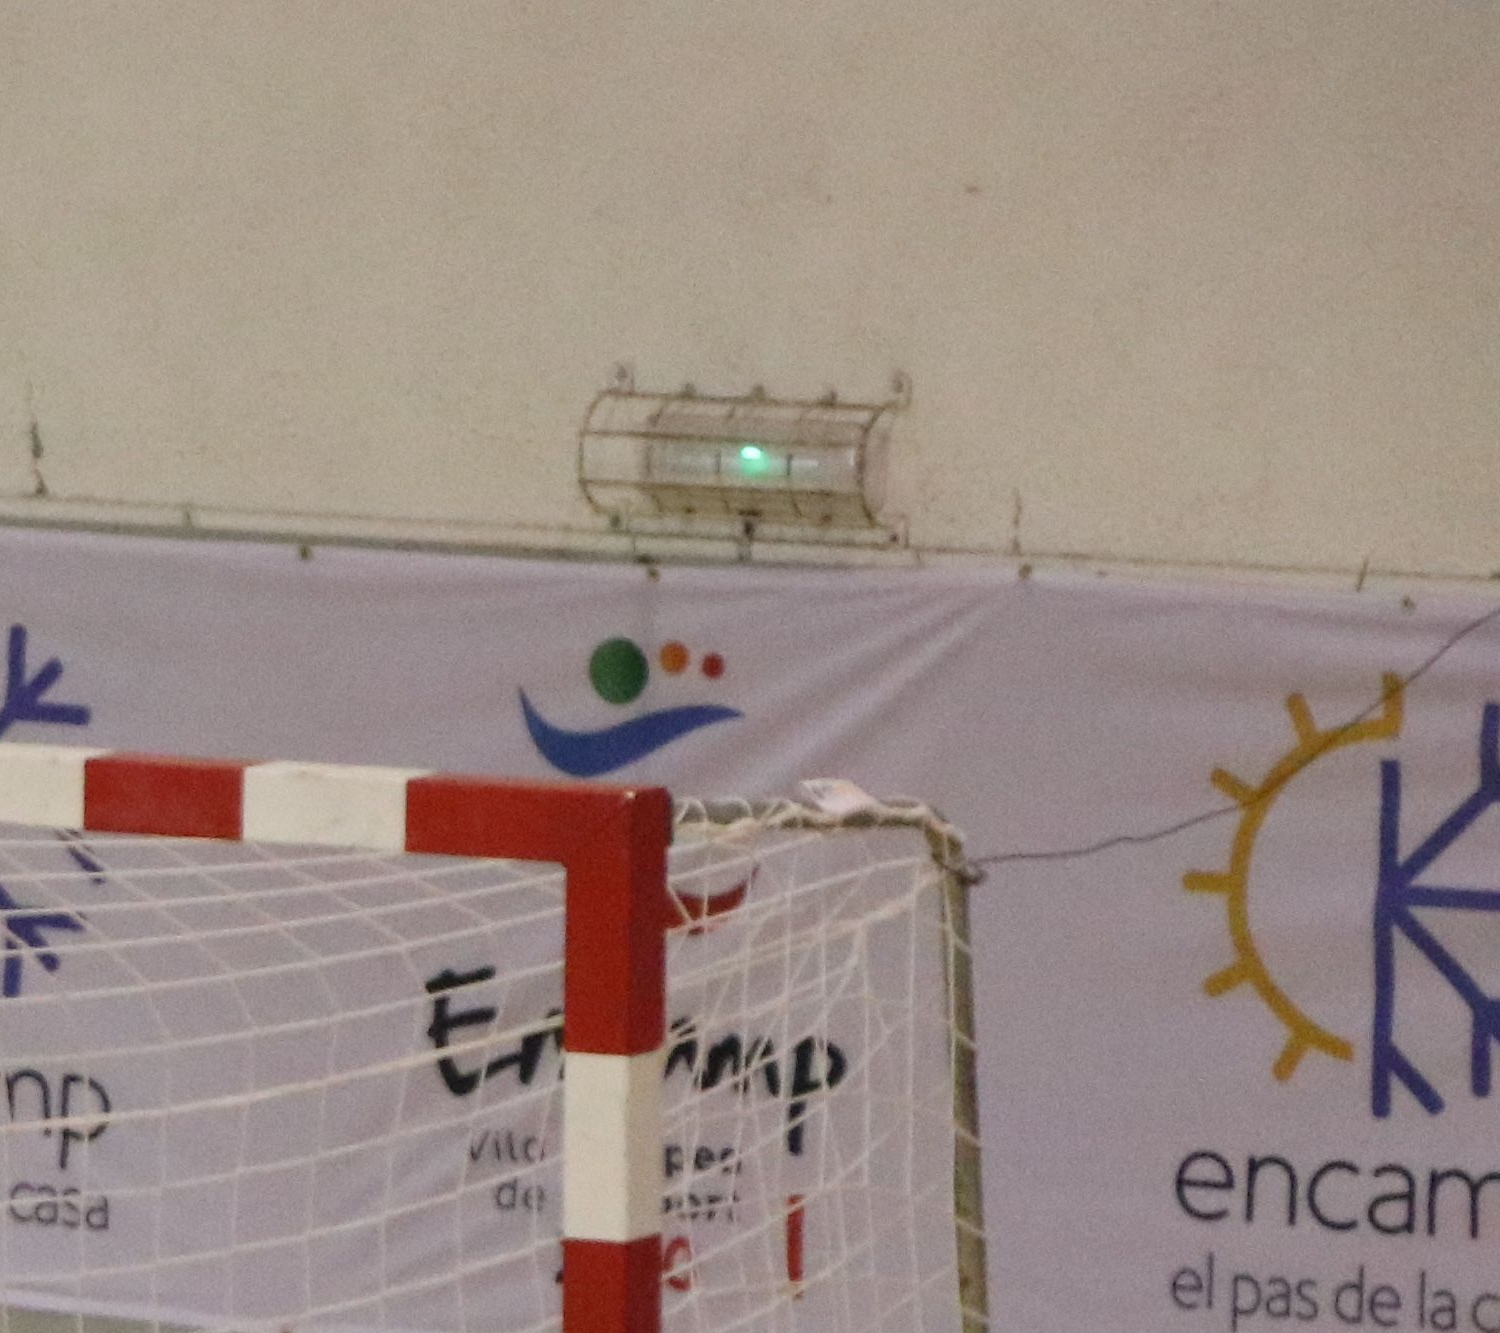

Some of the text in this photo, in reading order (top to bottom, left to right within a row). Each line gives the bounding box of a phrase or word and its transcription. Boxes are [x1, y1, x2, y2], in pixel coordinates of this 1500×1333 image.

[1175, 1150, 1500, 1239] encam
[1171, 1252, 1214, 1310] el
[1231, 1273, 1319, 1333] pas
[1334, 1264, 1400, 1327] de
[1419, 1269, 1457, 1332] la
